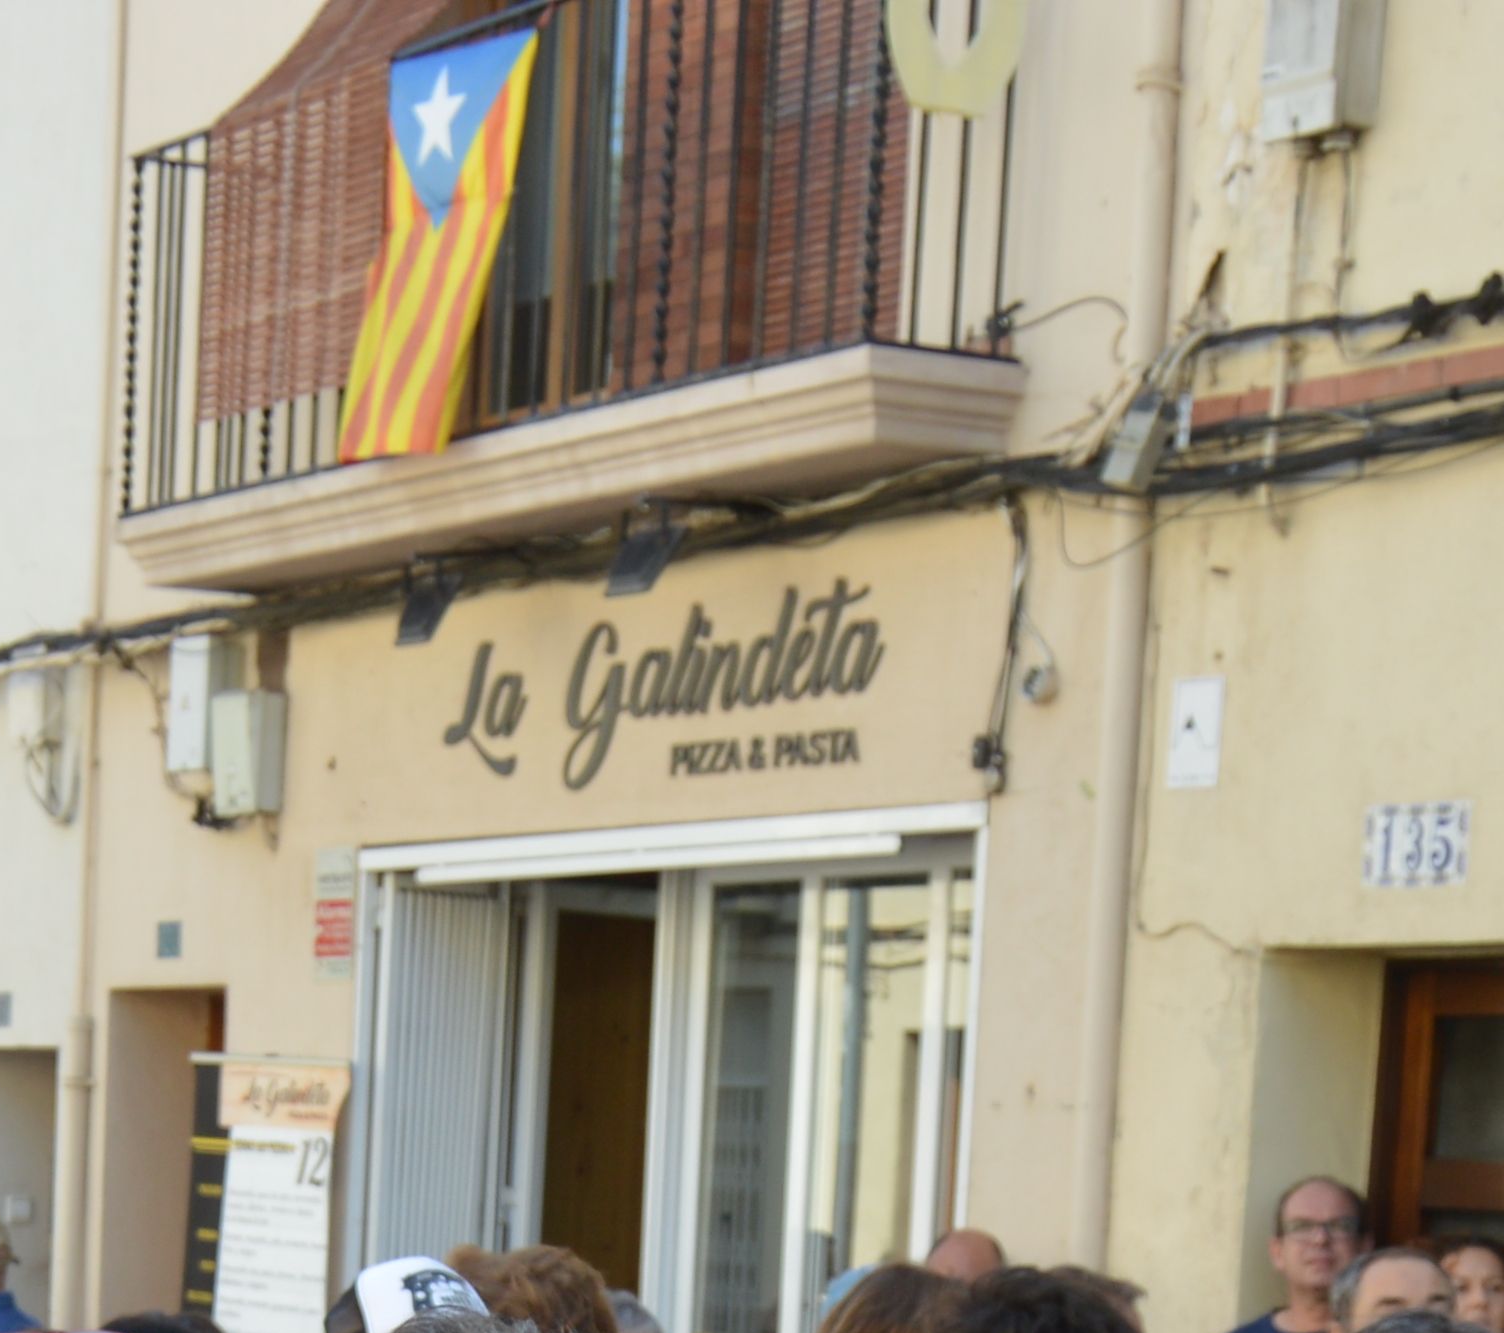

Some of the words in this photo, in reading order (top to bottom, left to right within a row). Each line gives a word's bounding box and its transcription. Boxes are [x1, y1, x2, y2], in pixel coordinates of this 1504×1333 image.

[442, 640, 529, 778] La
[669, 740, 742, 778] PIZZA
[747, 734, 766, 770] &
[773, 726, 862, 766] PASTA
[1380, 813, 1455, 875] 135
[294, 1136, 330, 1188] 12
